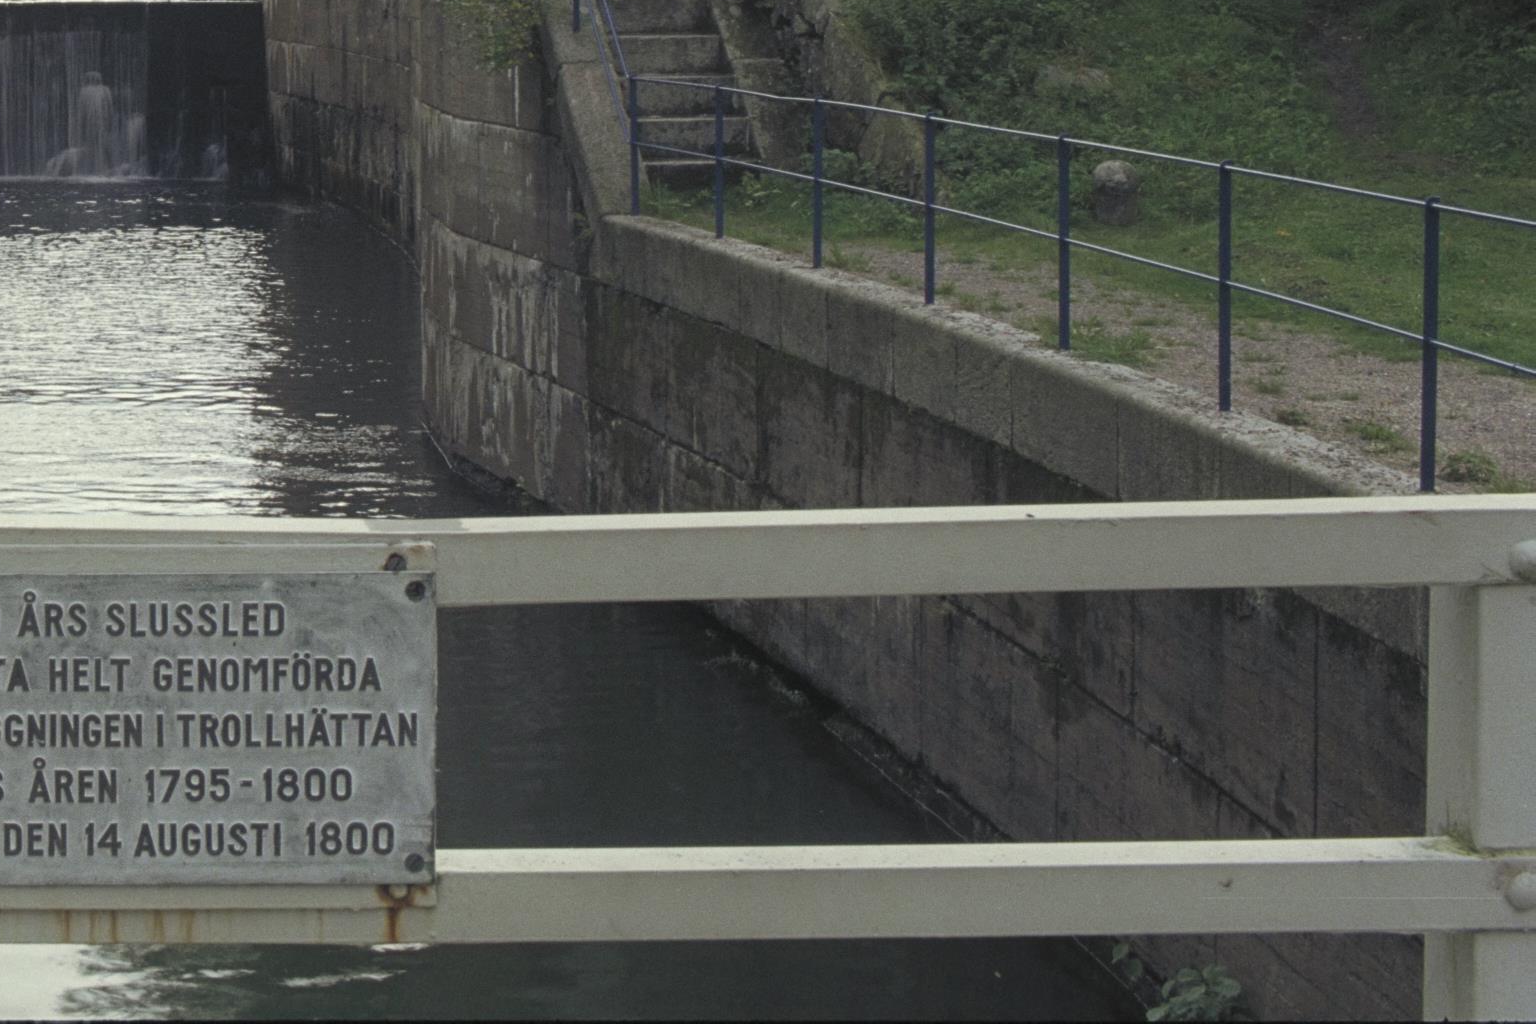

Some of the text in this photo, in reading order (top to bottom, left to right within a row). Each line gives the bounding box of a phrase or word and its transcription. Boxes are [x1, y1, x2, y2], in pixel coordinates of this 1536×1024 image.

[18, 591, 88, 638] ÅRS
[105, 602, 287, 638] SLUSSLED
[49, 657, 132, 692] HELT
[152, 651, 381, 692] GENOMFÖRDA
[156, 713, 164, 747] I
[177, 708, 418, 748] TROLLHÄTTAN
[28, 757, 118, 803] ÅREN
[4, 822, 67, 856] DEN
[84, 822, 122, 856] 14
[134, 821, 282, 858] AUGUSTI
[306, 821, 396, 856] 1800
